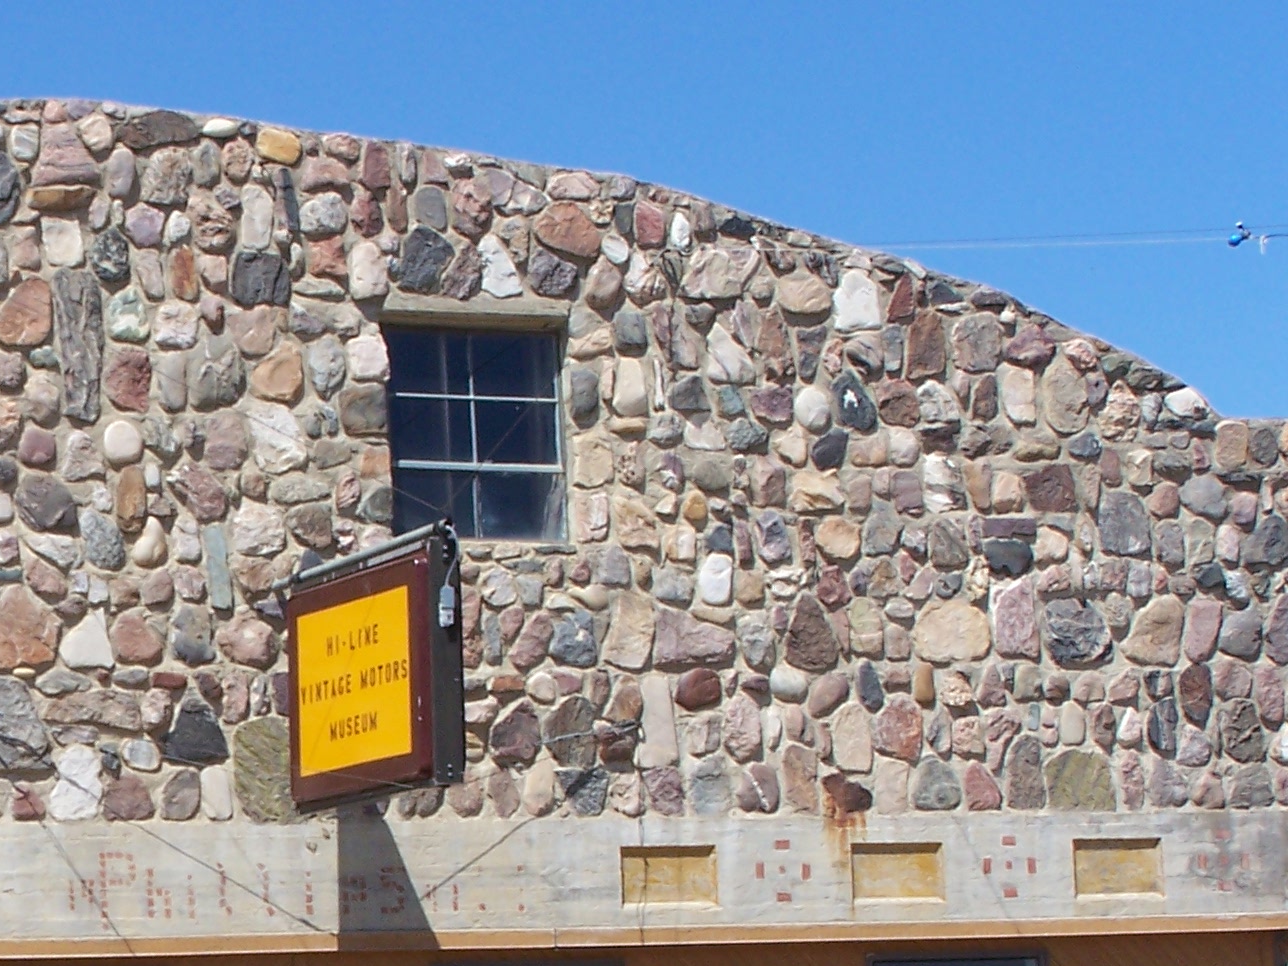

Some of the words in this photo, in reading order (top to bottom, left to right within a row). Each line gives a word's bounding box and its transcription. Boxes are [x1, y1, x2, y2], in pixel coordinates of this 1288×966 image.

[326, 623, 379, 656] HI-LINE
[300, 673, 352, 705] VINTAGE
[360, 658, 408, 690] MOTORS
[329, 711, 378, 742] MUSEUM
